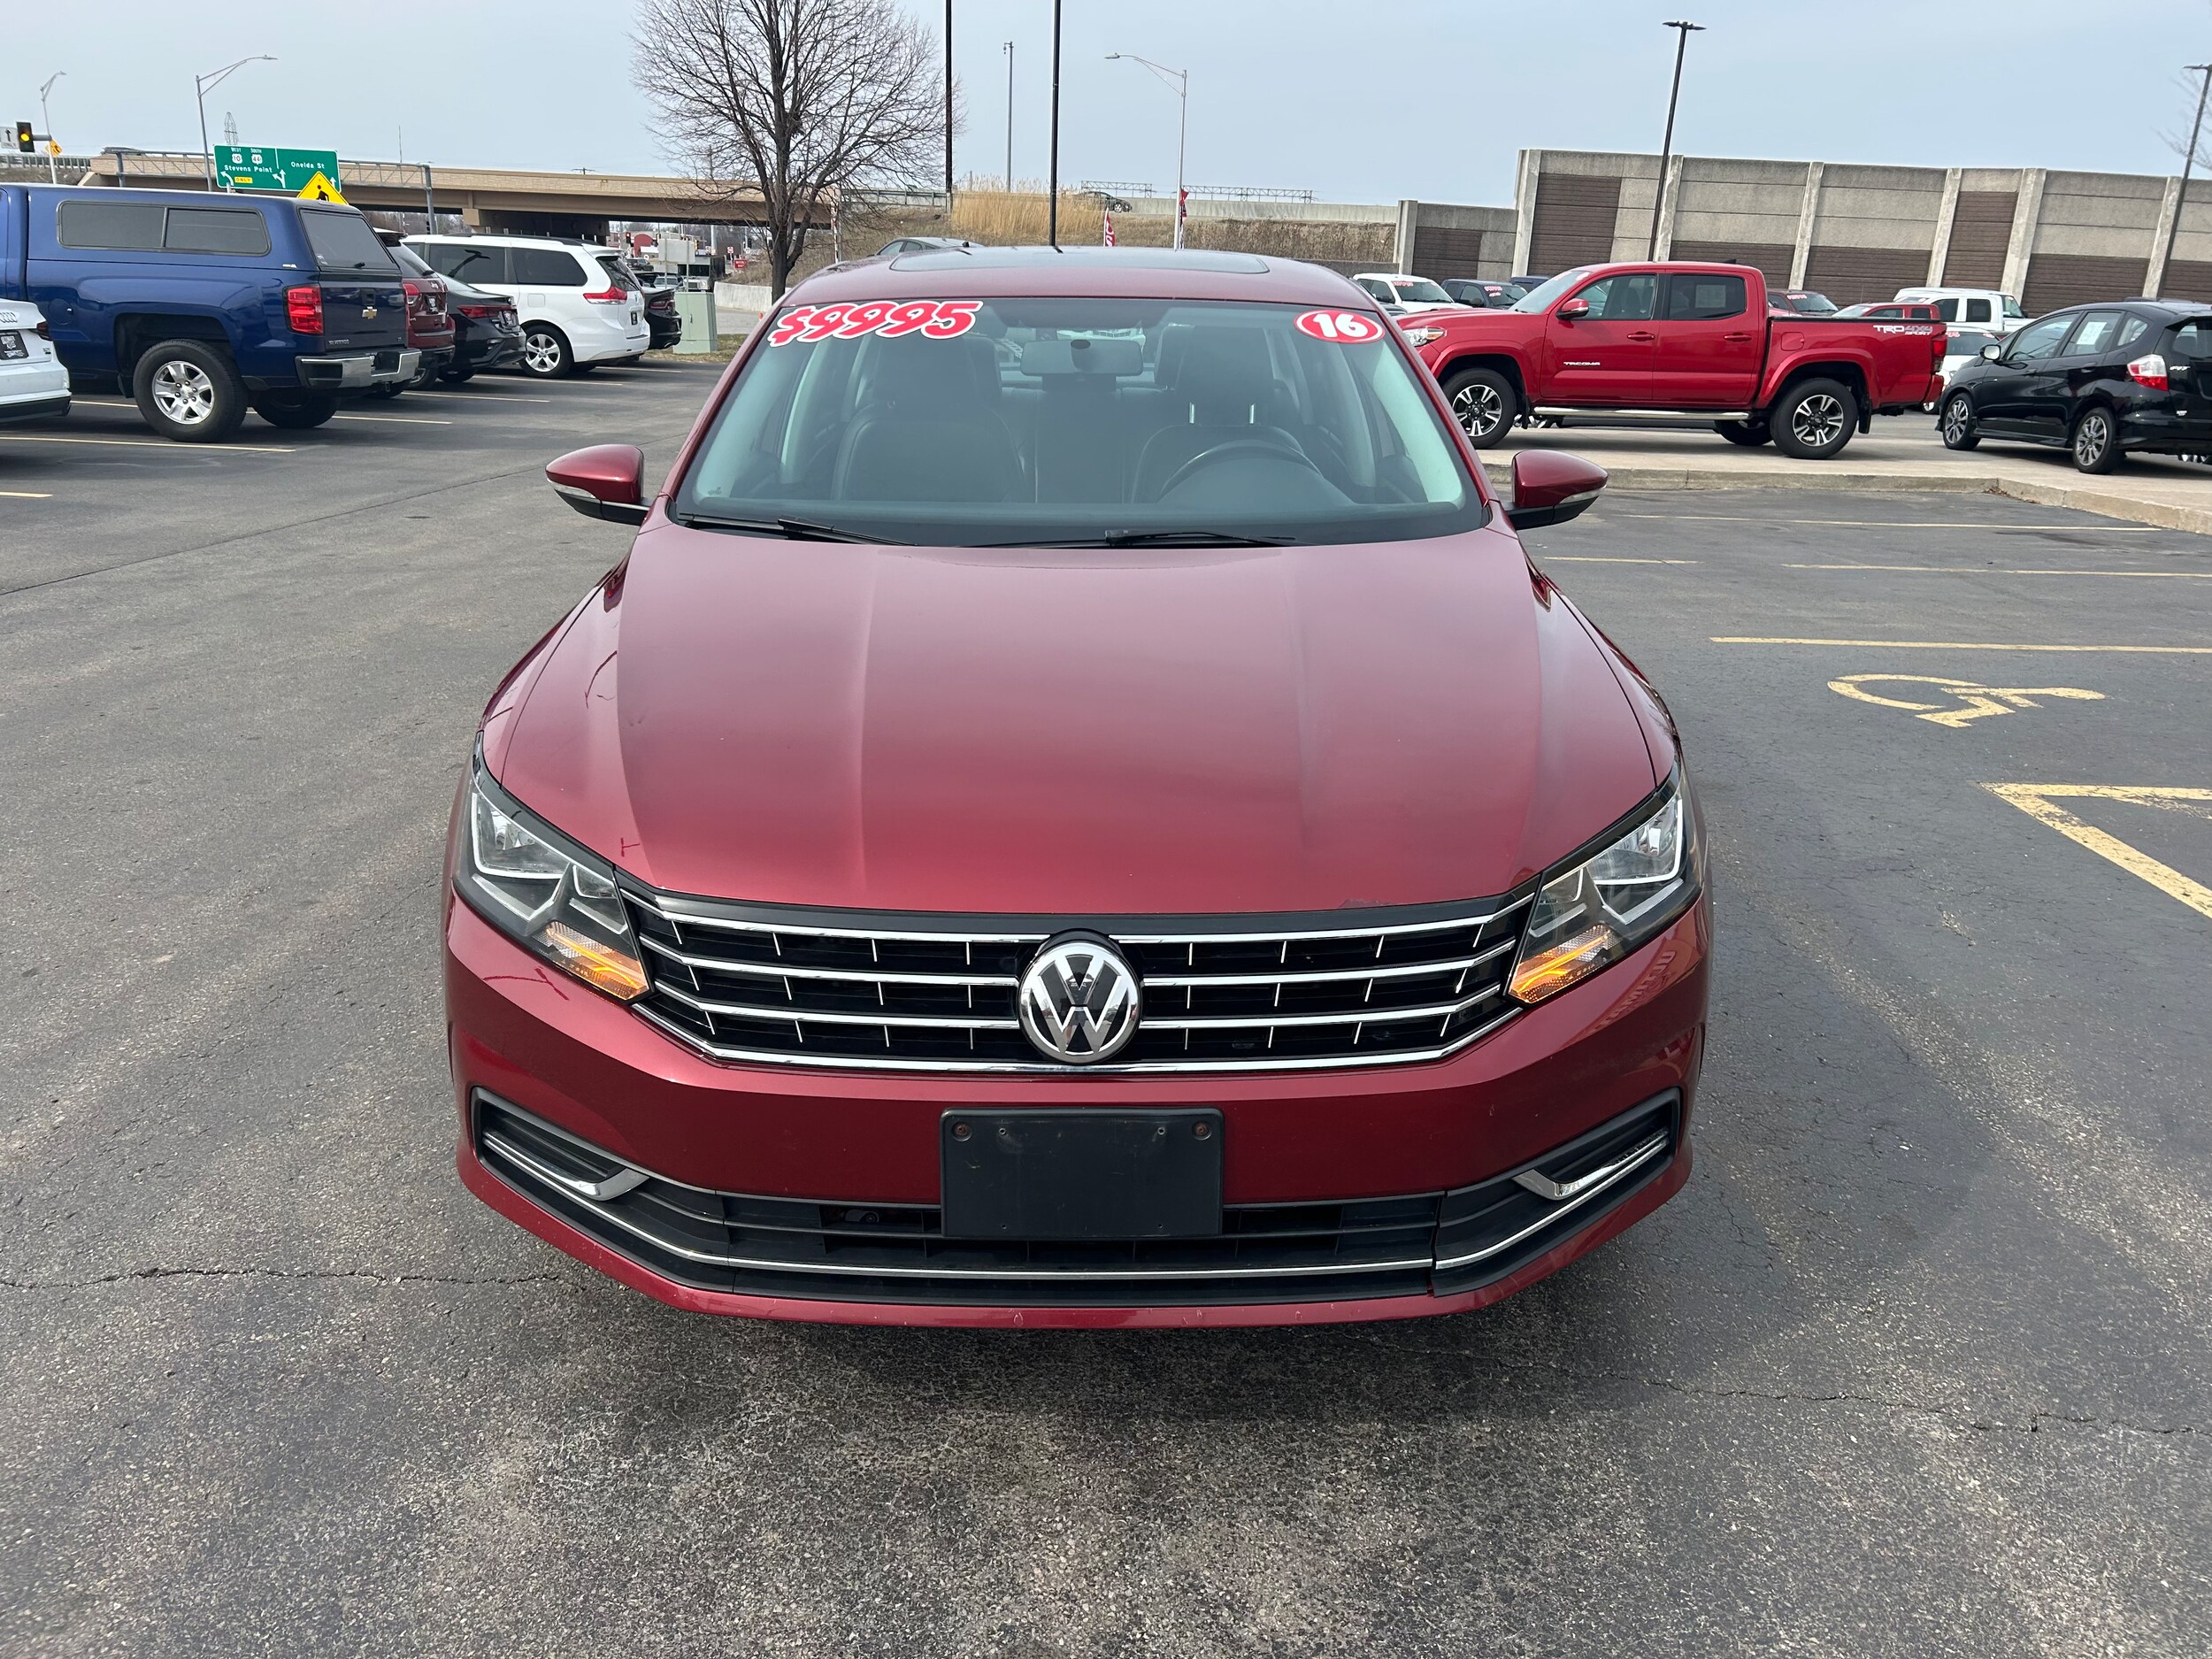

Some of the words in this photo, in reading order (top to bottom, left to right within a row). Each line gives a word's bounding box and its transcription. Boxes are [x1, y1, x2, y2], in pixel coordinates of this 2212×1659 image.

[767, 300, 984, 347] $9995
[1312, 313, 1369, 338] 16
[1873, 325, 1905, 334] TRD
